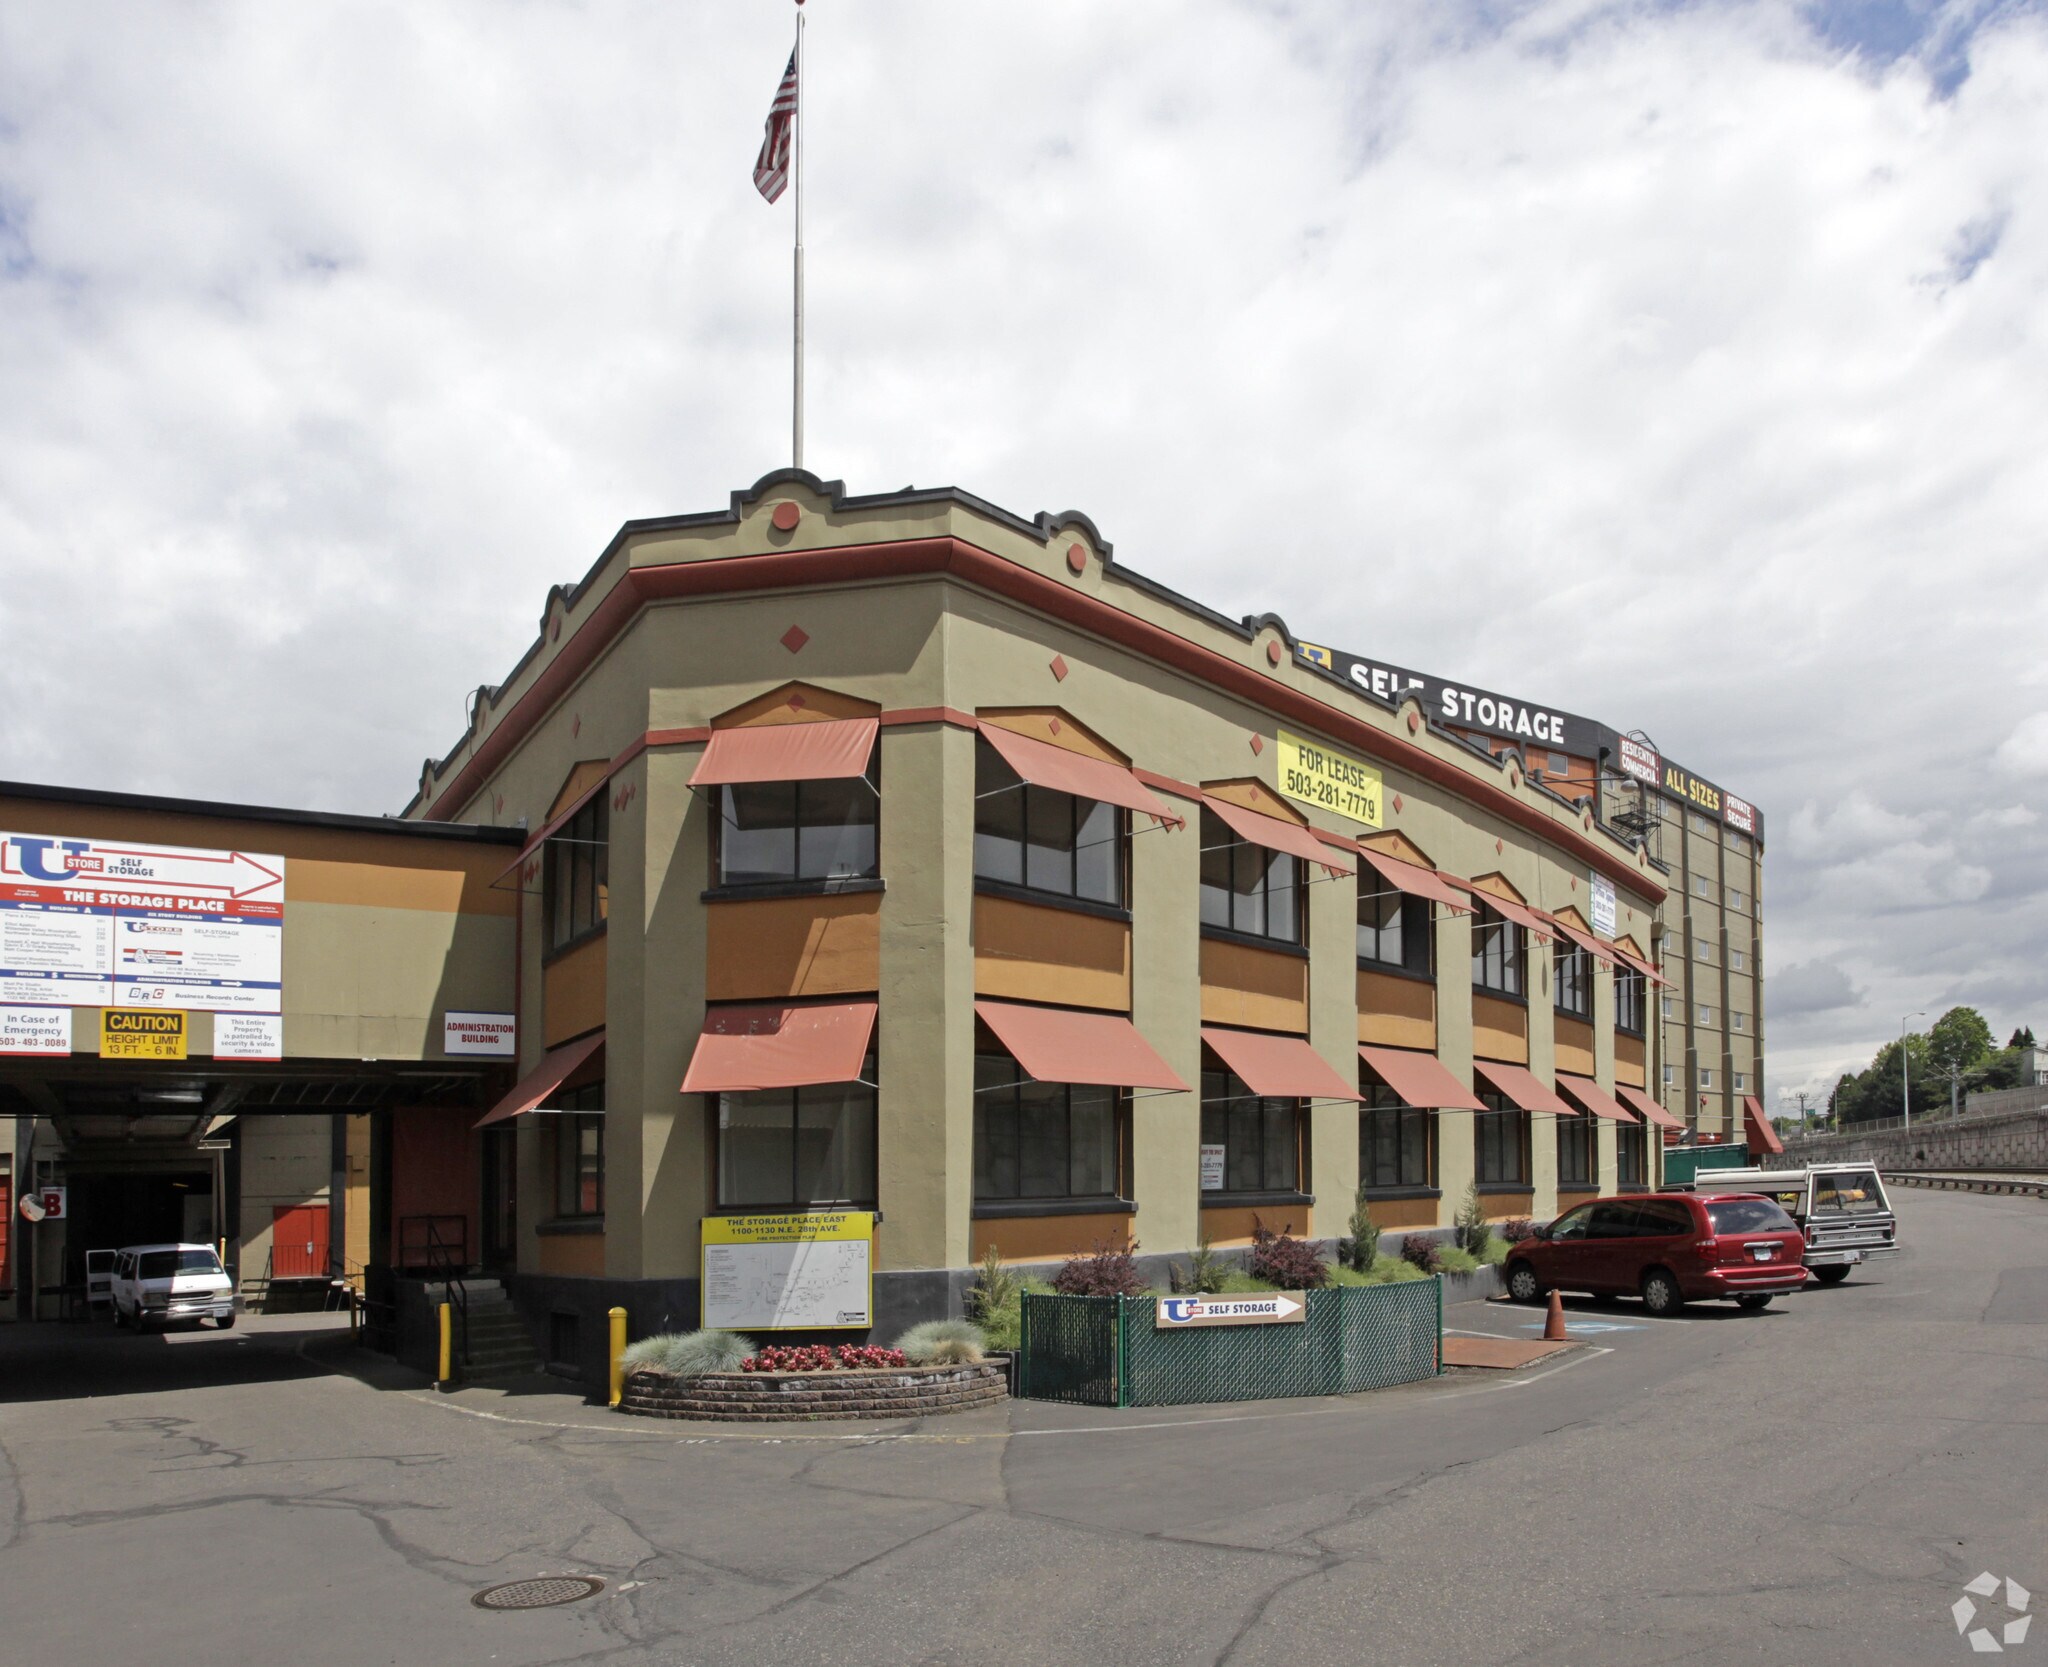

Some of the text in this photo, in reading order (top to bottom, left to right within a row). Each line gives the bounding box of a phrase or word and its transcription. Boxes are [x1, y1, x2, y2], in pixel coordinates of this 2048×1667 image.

[1441, 687, 1564, 744] STORAGE
[1298, 744, 1365, 791] FOR LEASE
[1287, 768, 1375, 820] 503-281-7779
[1665, 768, 1719, 811] ALL SIZES
[1727, 795, 1751, 818] PRIVATE
[1727, 809, 1752, 831] SECURE
[10, 836, 90, 881] U
[67, 858, 101, 870] STORE
[120, 858, 143, 867] SELF
[108, 865, 155, 877] STORAGE
[63, 890, 225, 912] THE STORAGE PLACE
[194, 928, 240, 936] SELF-STORAGE
[7, 1014, 60, 1024] In Case of
[109, 1014, 179, 1031] CAUTION
[4, 1025, 63, 1037] Emergency
[446, 1022, 514, 1034] ADMINISTRATION
[106, 1034, 180, 1045] HEIGHT LIMIT
[461, 1034, 500, 1044] BUILDING
[108, 1045, 120, 1054] 13
[124, 1045, 142, 1054] FT.
[154, 1046, 162, 1055] 6
[166, 1046, 180, 1056] IN.
[44, 1194, 62, 1216] B
[747, 1217, 789, 1225] STORAGE
[731, 1227, 775, 1235] 1100-1130
[1164, 1299, 1198, 1321] U
[1208, 1303, 1277, 1314] SELF STORAGE
